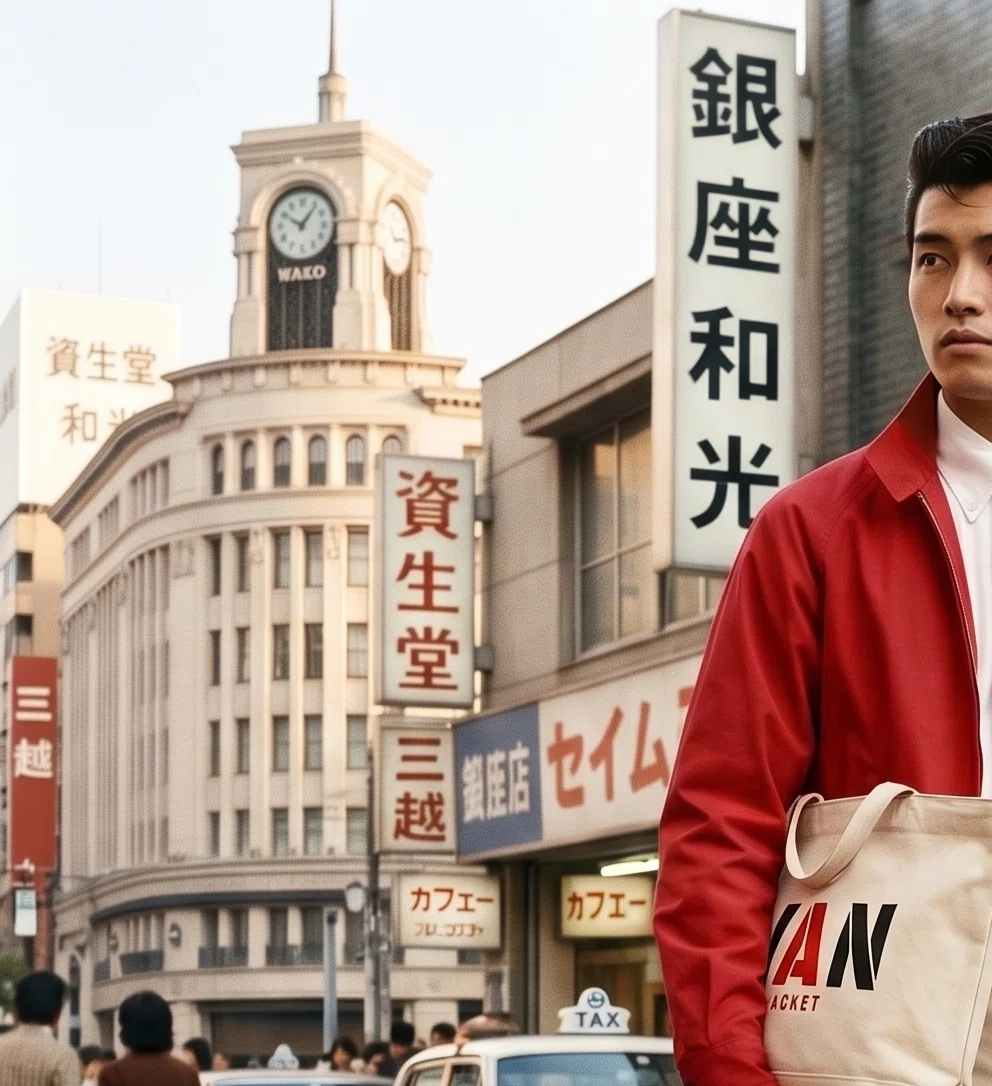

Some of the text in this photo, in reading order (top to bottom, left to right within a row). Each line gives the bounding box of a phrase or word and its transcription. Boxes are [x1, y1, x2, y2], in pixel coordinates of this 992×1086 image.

[277, 264, 326, 283] WAKO
[688, 46, 782, 530] 銀座和光
[46, 335, 157, 386] 資生堂
[396, 470, 460, 691] 資生堂
[14, 685, 53, 779] 三越
[394, 737, 446, 842] 三越
[575, 1012, 620, 1028] TAX
[768, 993, 821, 1012] ACKET
